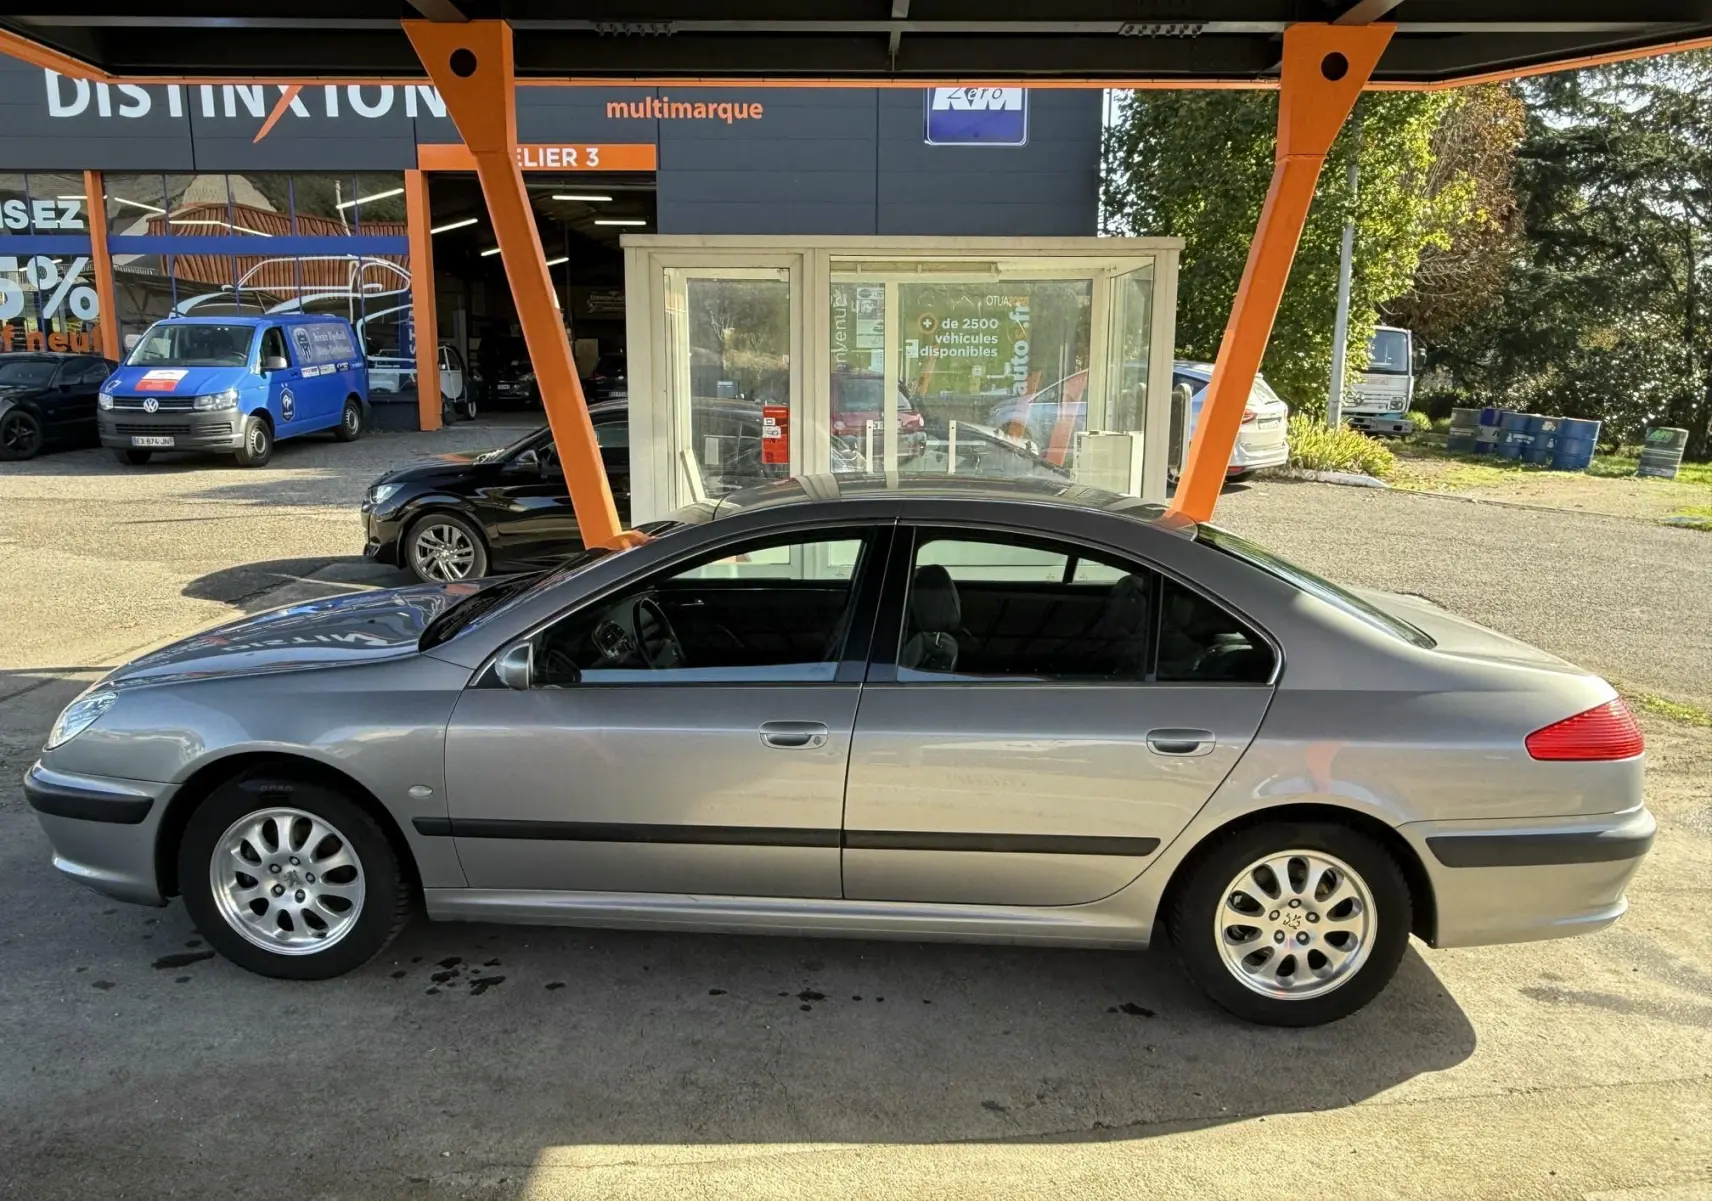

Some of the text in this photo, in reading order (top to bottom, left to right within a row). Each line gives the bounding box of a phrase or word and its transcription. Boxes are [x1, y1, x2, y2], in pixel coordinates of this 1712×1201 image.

[606, 96, 764, 124] multimarque
[585, 147, 600, 167] 3
[941, 318, 958, 329] de
[963, 318, 998, 329] 2500
[935, 332, 998, 344] véhicules
[920, 346, 998, 359] disponibles
